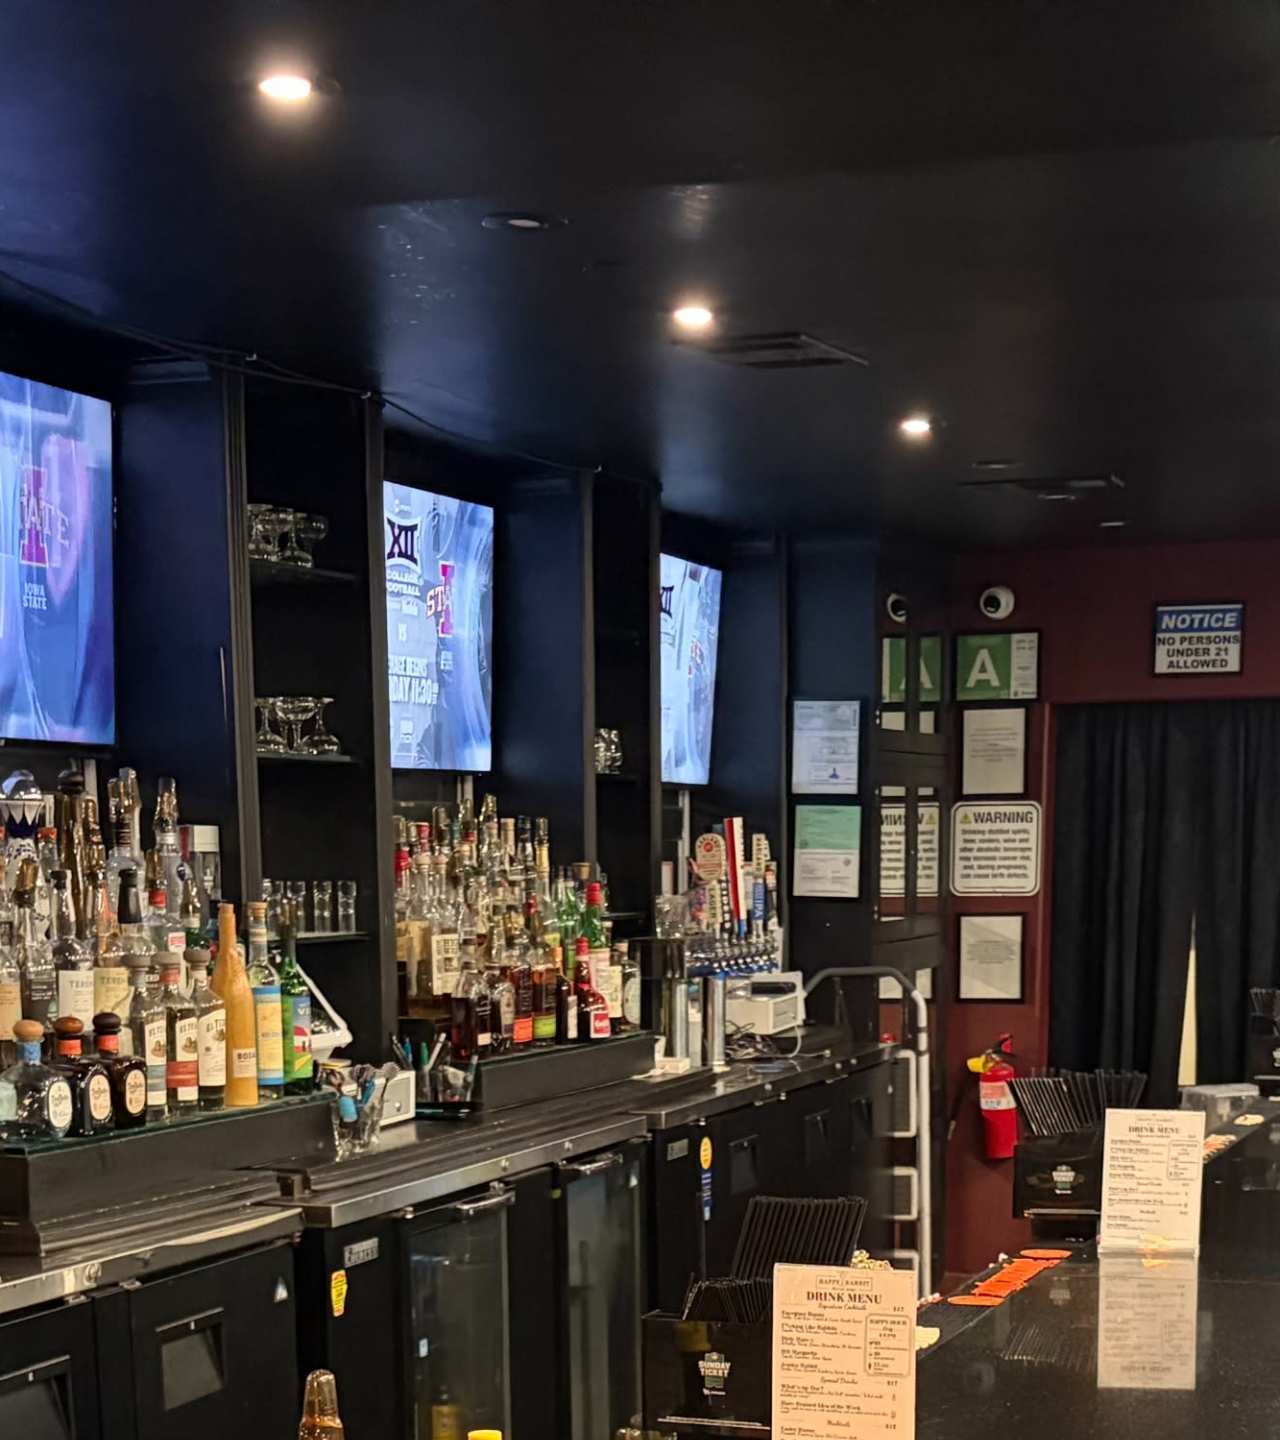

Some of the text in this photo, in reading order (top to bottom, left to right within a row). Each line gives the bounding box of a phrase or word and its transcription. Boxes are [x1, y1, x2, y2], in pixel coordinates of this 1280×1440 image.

[1161, 611, 1239, 630] NOTICE
[1157, 634, 1240, 647] NO PERSONS
[1166, 646, 1229, 659] UNDER 21
[965, 648, 1001, 688] A
[1167, 658, 1229, 670] ALLOWED
[972, 811, 1034, 825] WARNING
[806, 1290, 883, 1305] DRINK MENU
